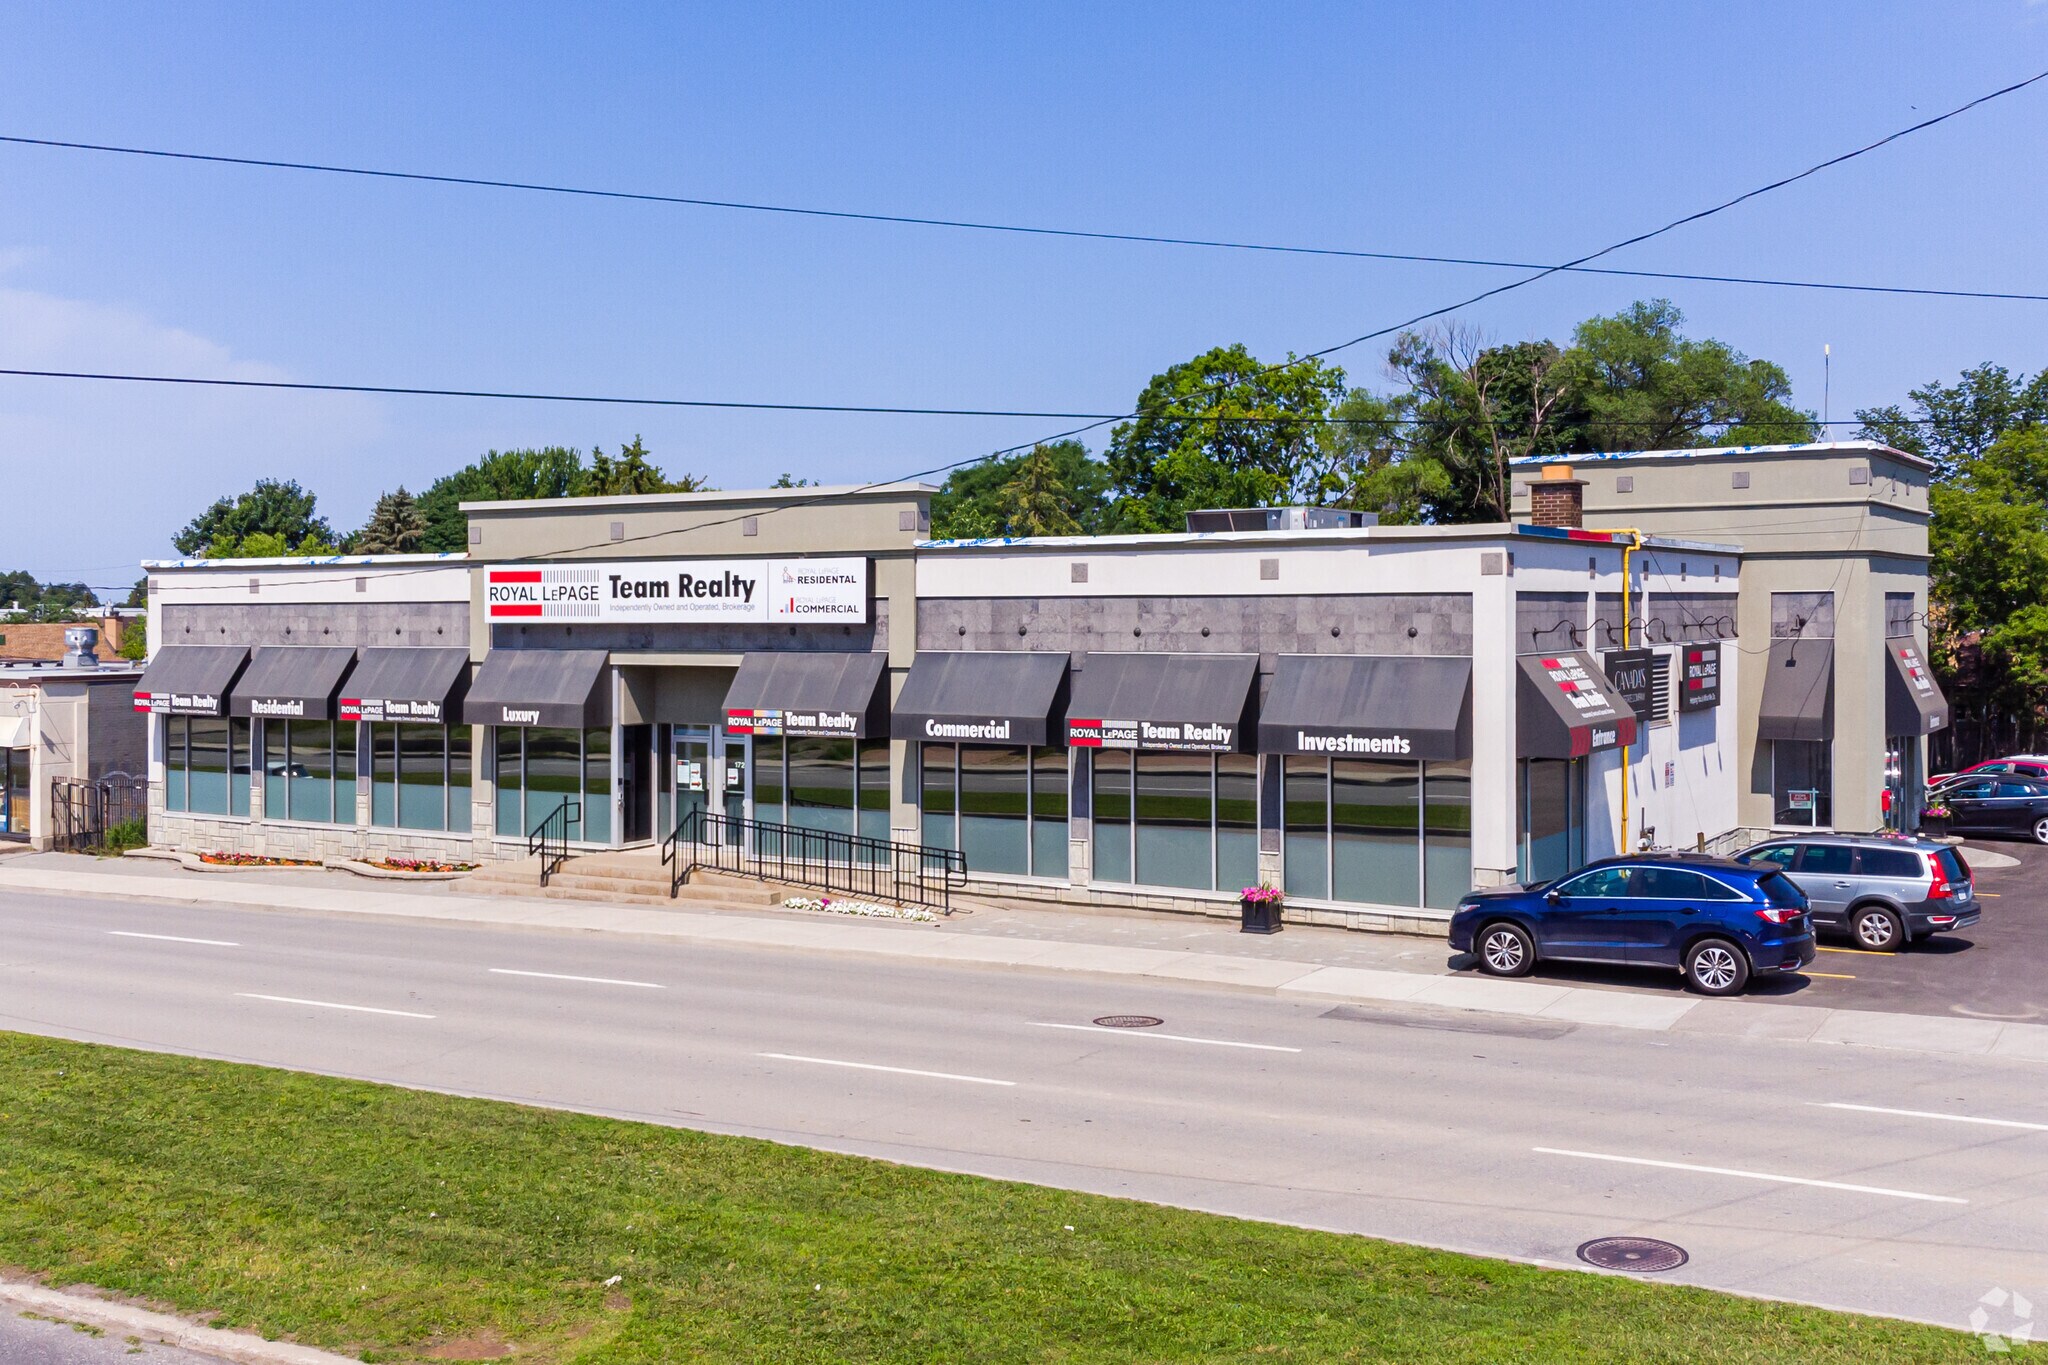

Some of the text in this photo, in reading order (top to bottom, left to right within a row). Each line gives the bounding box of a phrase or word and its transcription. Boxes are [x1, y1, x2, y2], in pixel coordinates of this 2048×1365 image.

[490, 586, 538, 601] ROYAL
[609, 571, 756, 603] Team Realty
[610, 604, 652, 612] Independently
[676, 603, 688, 611] and
[689, 603, 721, 612] Operated,
[722, 603, 755, 612] Brokerage
[796, 605, 859, 613] COMMERCIAL
[171, 694, 218, 710] Team Realty
[251, 699, 303, 716] Residential
[385, 700, 440, 717] Team Realty
[502, 706, 540, 725] Luxury
[728, 717, 753, 726] ROYAL
[785, 711, 857, 731] Team Realty
[925, 718, 1010, 740] Commercial
[1070, 728, 1101, 738] ROYAL
[1141, 722, 1232, 745] Team Realty
[1297, 731, 1411, 754] Investments
[1592, 729, 1616, 747] Entrance
